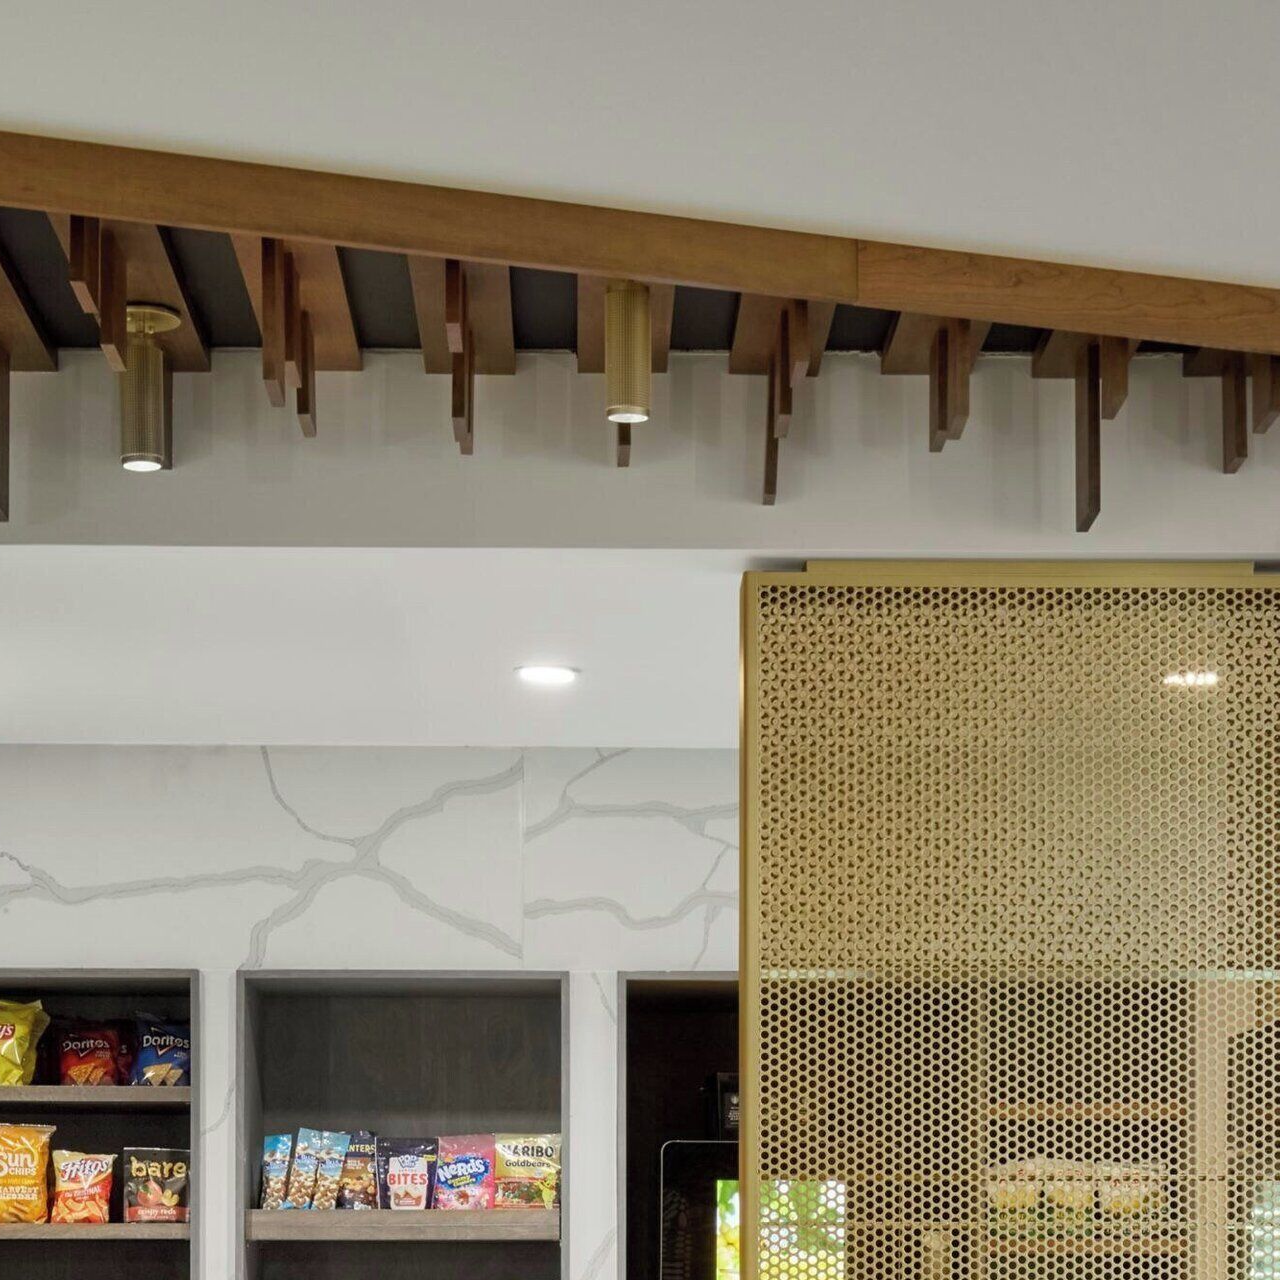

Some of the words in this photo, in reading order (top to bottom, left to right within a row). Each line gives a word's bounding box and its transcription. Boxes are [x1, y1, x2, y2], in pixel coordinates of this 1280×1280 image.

[62, 1039, 110, 1052] Doritos
[142, 1035, 190, 1049] Doritos
[348, 1143, 375, 1153] NTERS
[8, 1167, 37, 1176] CHIPS
[61, 1159, 109, 1181] Fritos
[130, 1156, 187, 1178] bare
[388, 1173, 427, 1185] BITES
